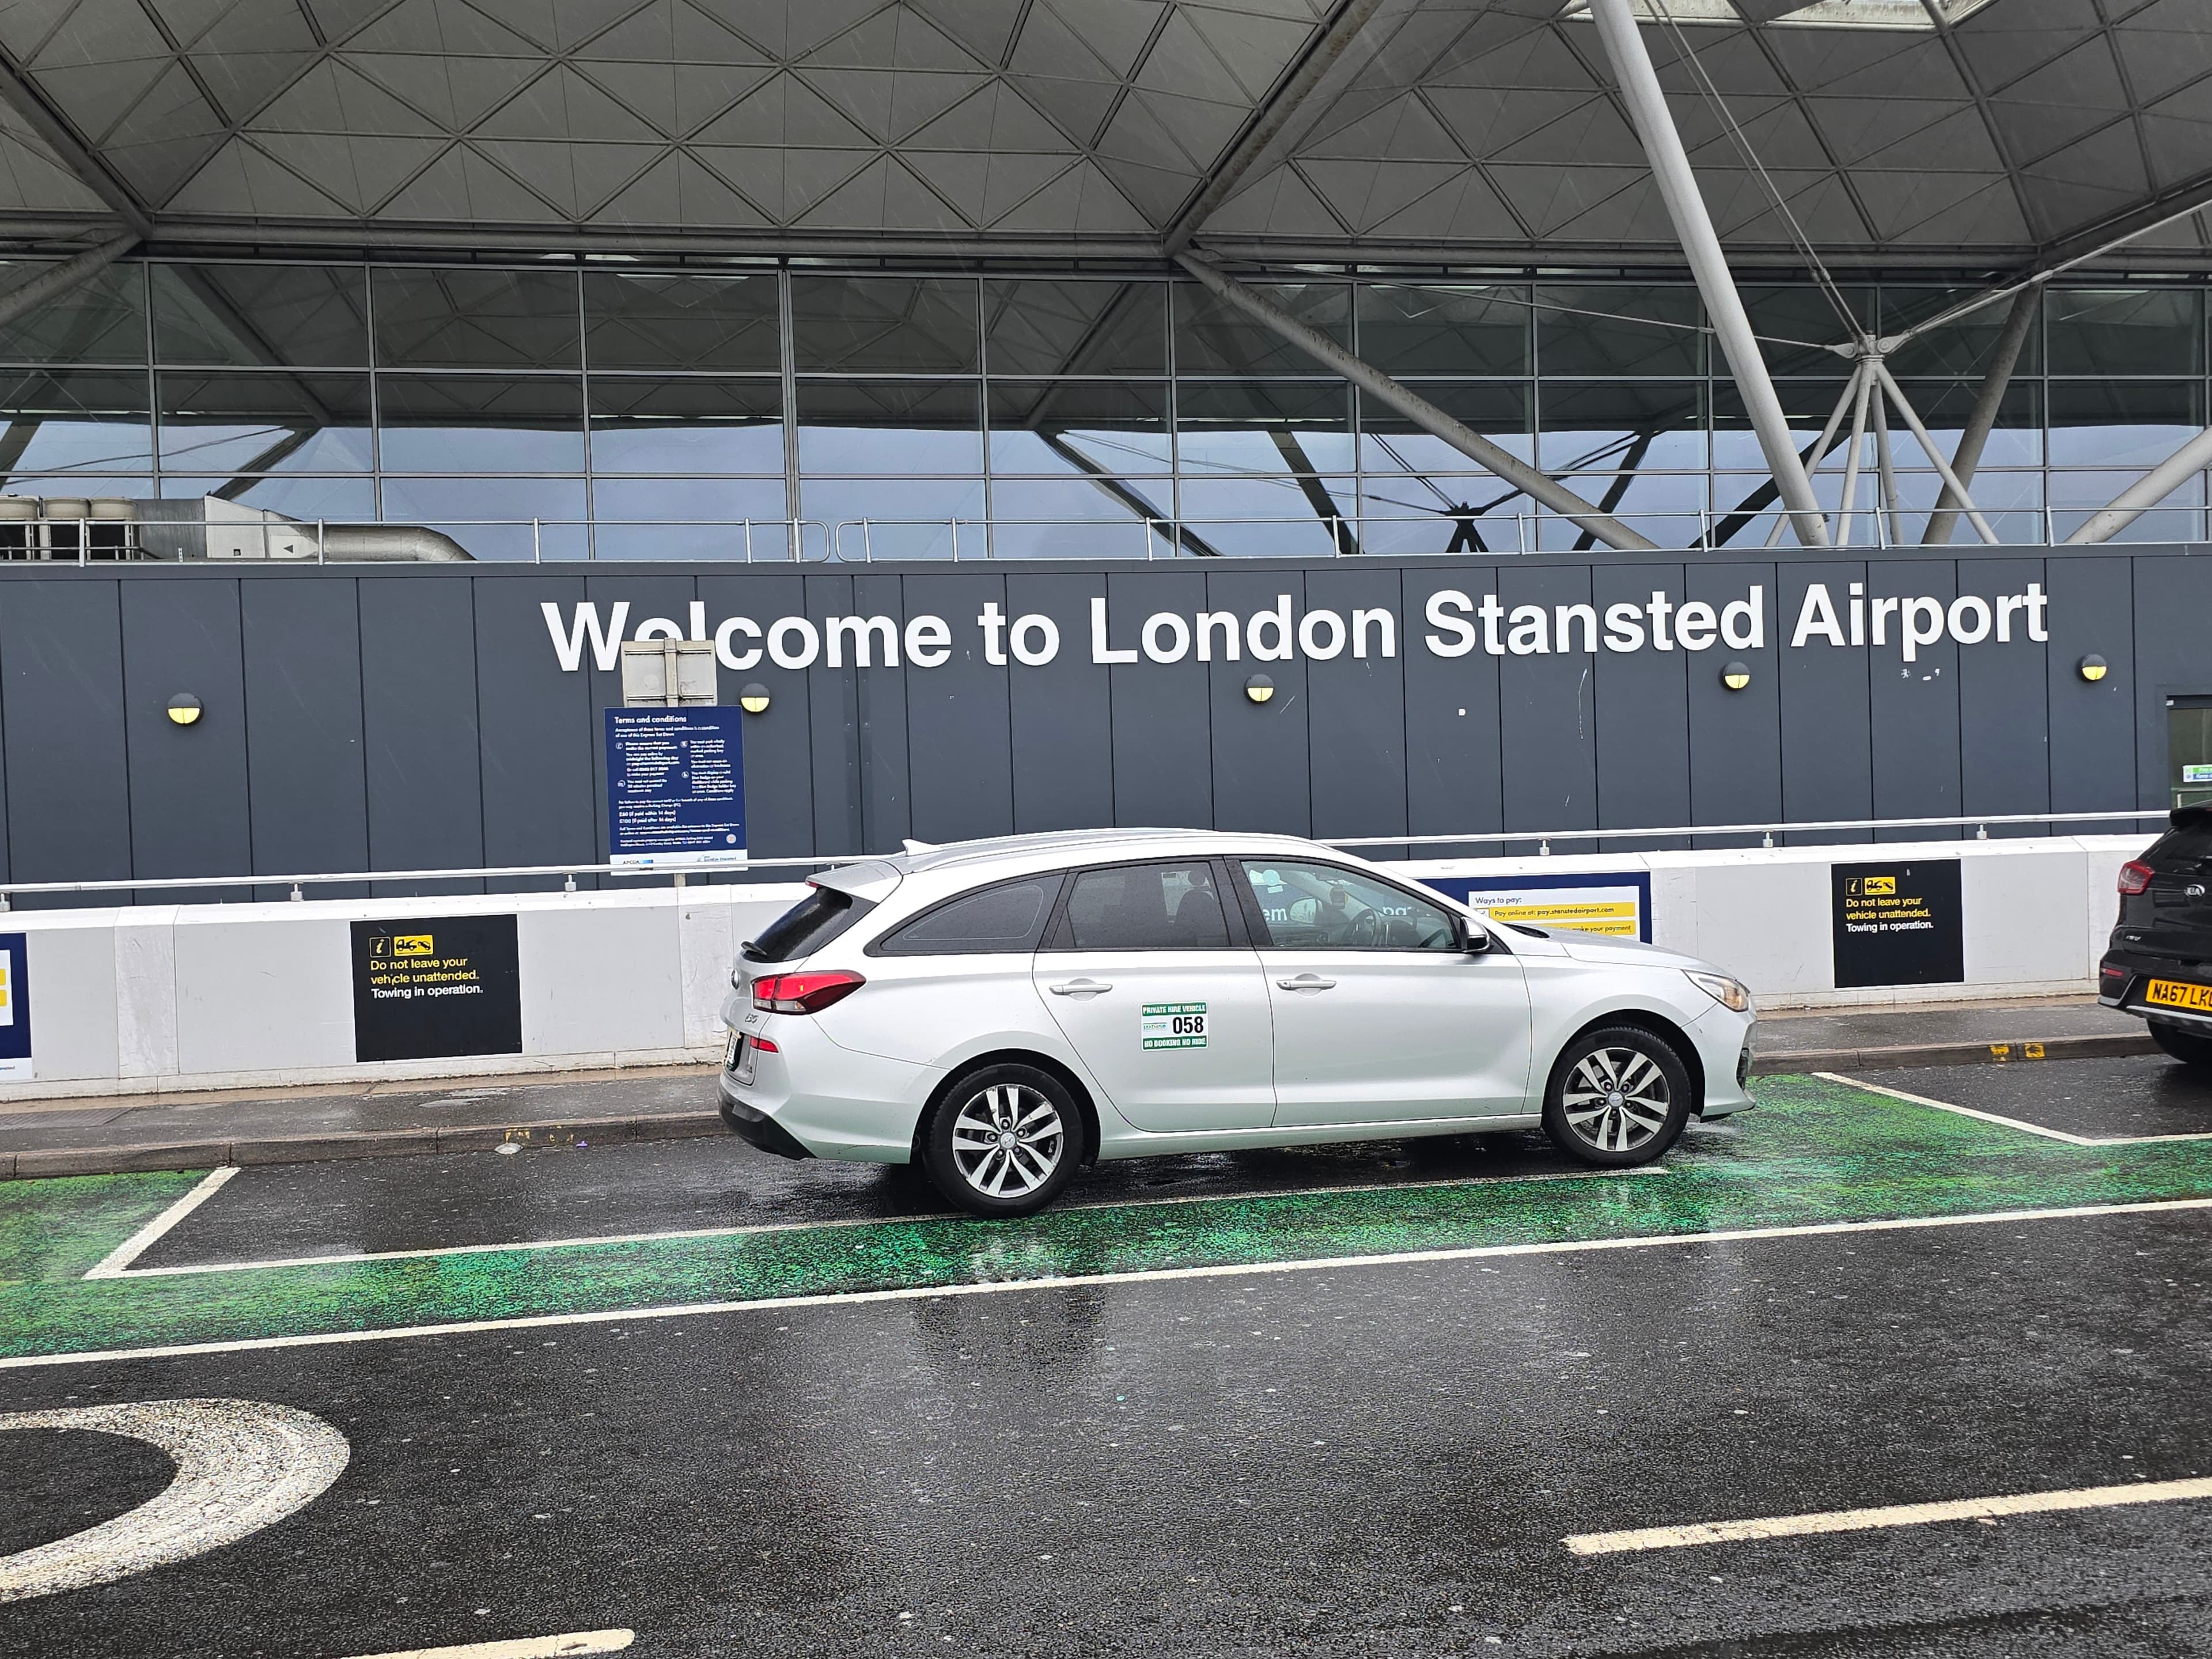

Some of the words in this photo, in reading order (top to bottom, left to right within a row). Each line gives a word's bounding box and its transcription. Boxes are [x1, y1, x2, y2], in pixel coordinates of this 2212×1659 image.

[978, 603, 1059, 666] to
[1090, 594, 1396, 664] London
[1424, 585, 1764, 658] Stansted
[1790, 583, 2048, 662] Airport
[652, 715, 687, 723] conditions
[1475, 897, 1495, 905] Ways
[1506, 897, 1522, 905] pay:
[1846, 898, 1859, 907] Do
[1861, 898, 1876, 907] not
[1878, 897, 1900, 906] leave
[1902, 897, 1922, 907] your
[1846, 910, 1876, 920] vehicle
[1878, 908, 1931, 919] unattended.
[1846, 923, 1878, 933] Towing
[1880, 922, 1888, 931] in
[1889, 921, 1933, 932] operation.
[370, 959, 386, 971] Do
[390, 959, 408, 969] not
[411, 958, 440, 968] leave
[442, 957, 468, 969] your
[370, 974, 410, 986] vehicle
[412, 969, 480, 983] unattended.
[371, 987, 412, 999] Towing
[414, 986, 425, 997] in
[427, 984, 483, 997] operation.
[2152, 983, 2188, 1003] NA67
[1143, 1006, 1166, 1014] PRIVATE
[1173, 1016, 1204, 1034] 058
[1192, 1037, 1206, 1046] RIDE
